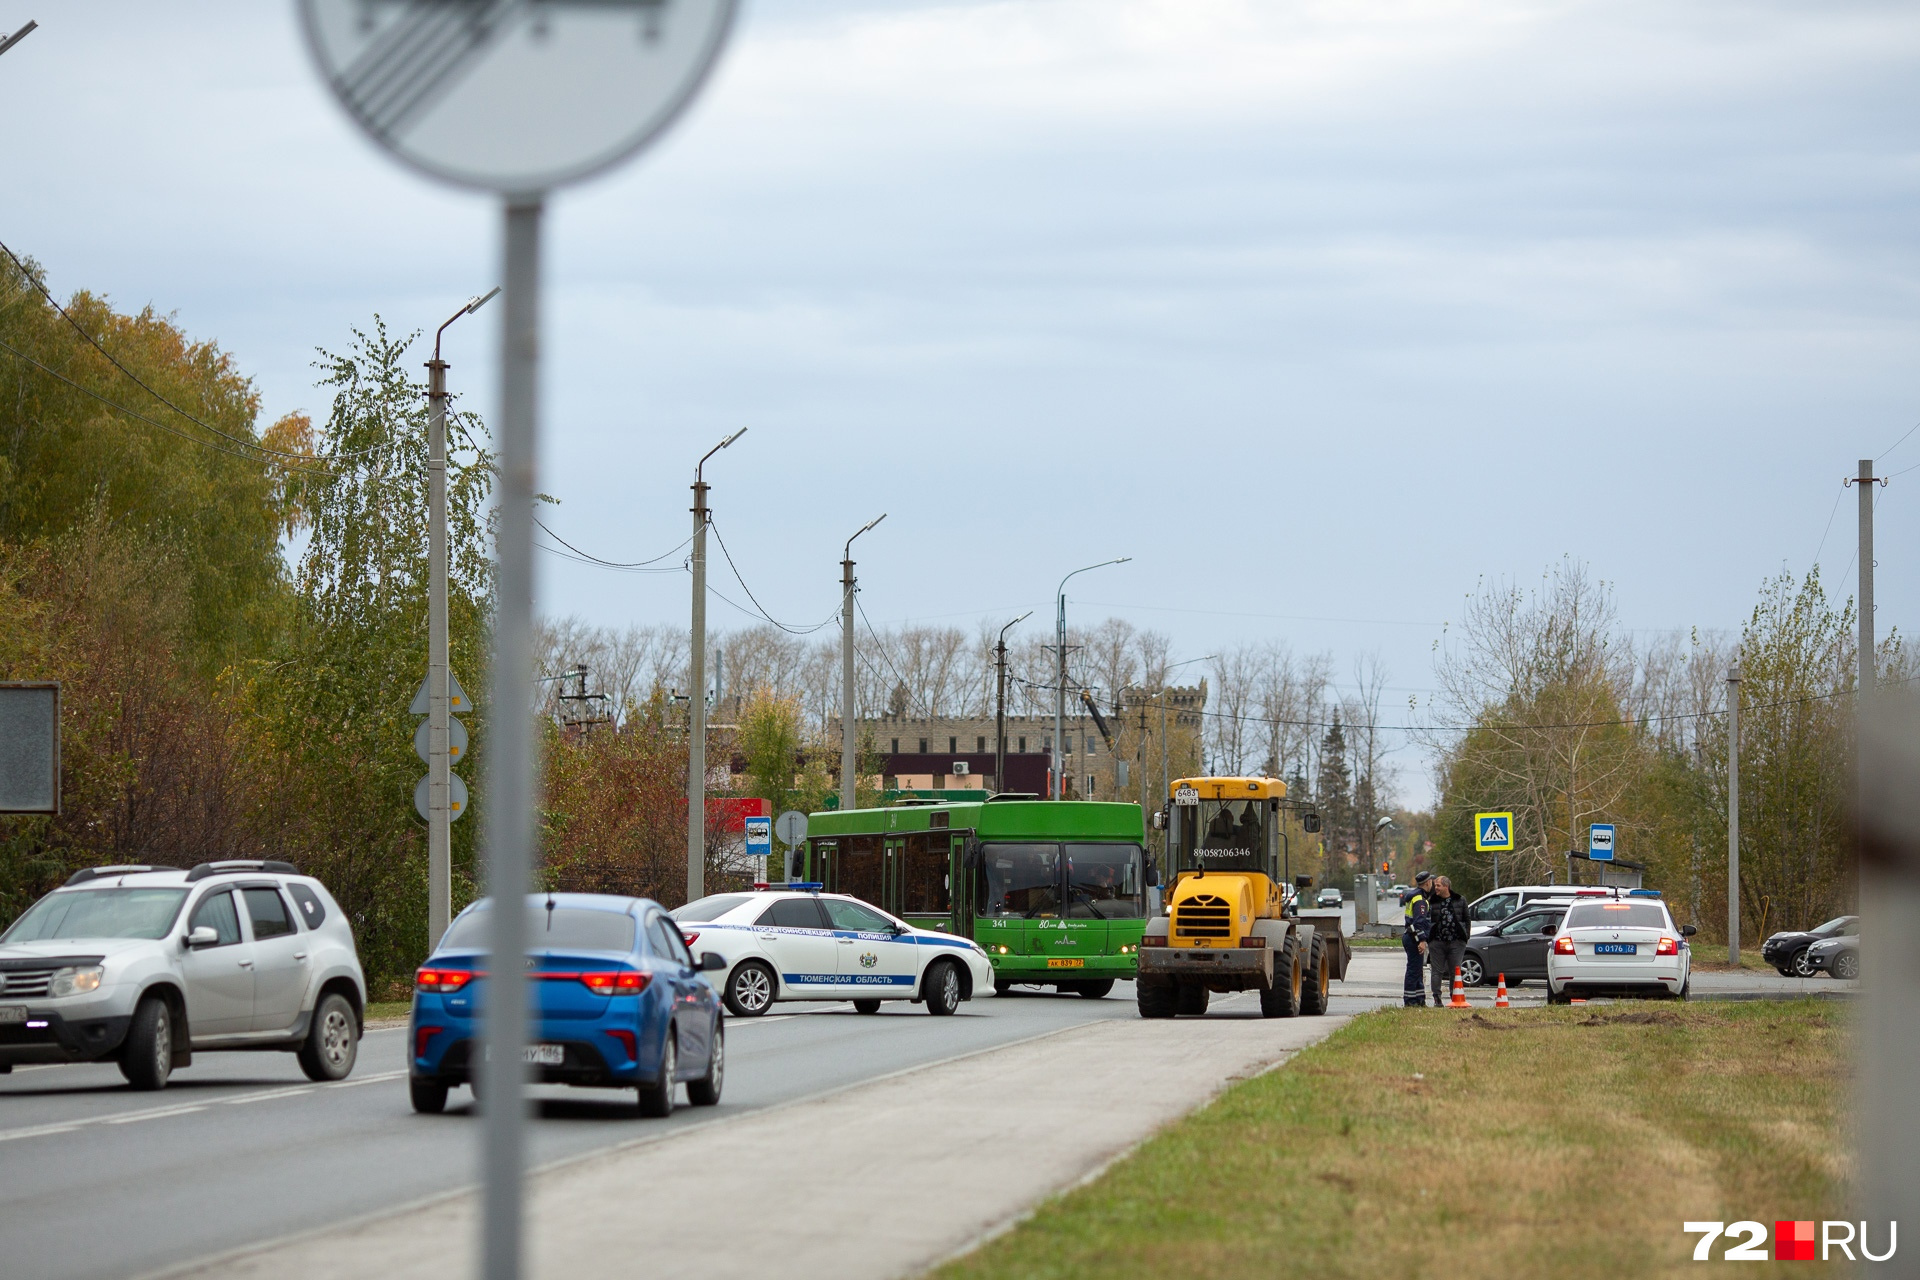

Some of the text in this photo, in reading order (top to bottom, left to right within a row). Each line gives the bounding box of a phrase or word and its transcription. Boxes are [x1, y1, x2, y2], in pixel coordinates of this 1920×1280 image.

[1193, 847, 1250, 857] 89058206346
[992, 920, 1007, 928] 341
[1039, 920, 1050, 928] 80
[753, 926, 832, 937] ГОСАВТОИНСПЕКЦИЯ
[857, 933, 892, 941] ПОЛИЦИЯ
[800, 975, 851, 983] ТЮМЕНСКАЯ
